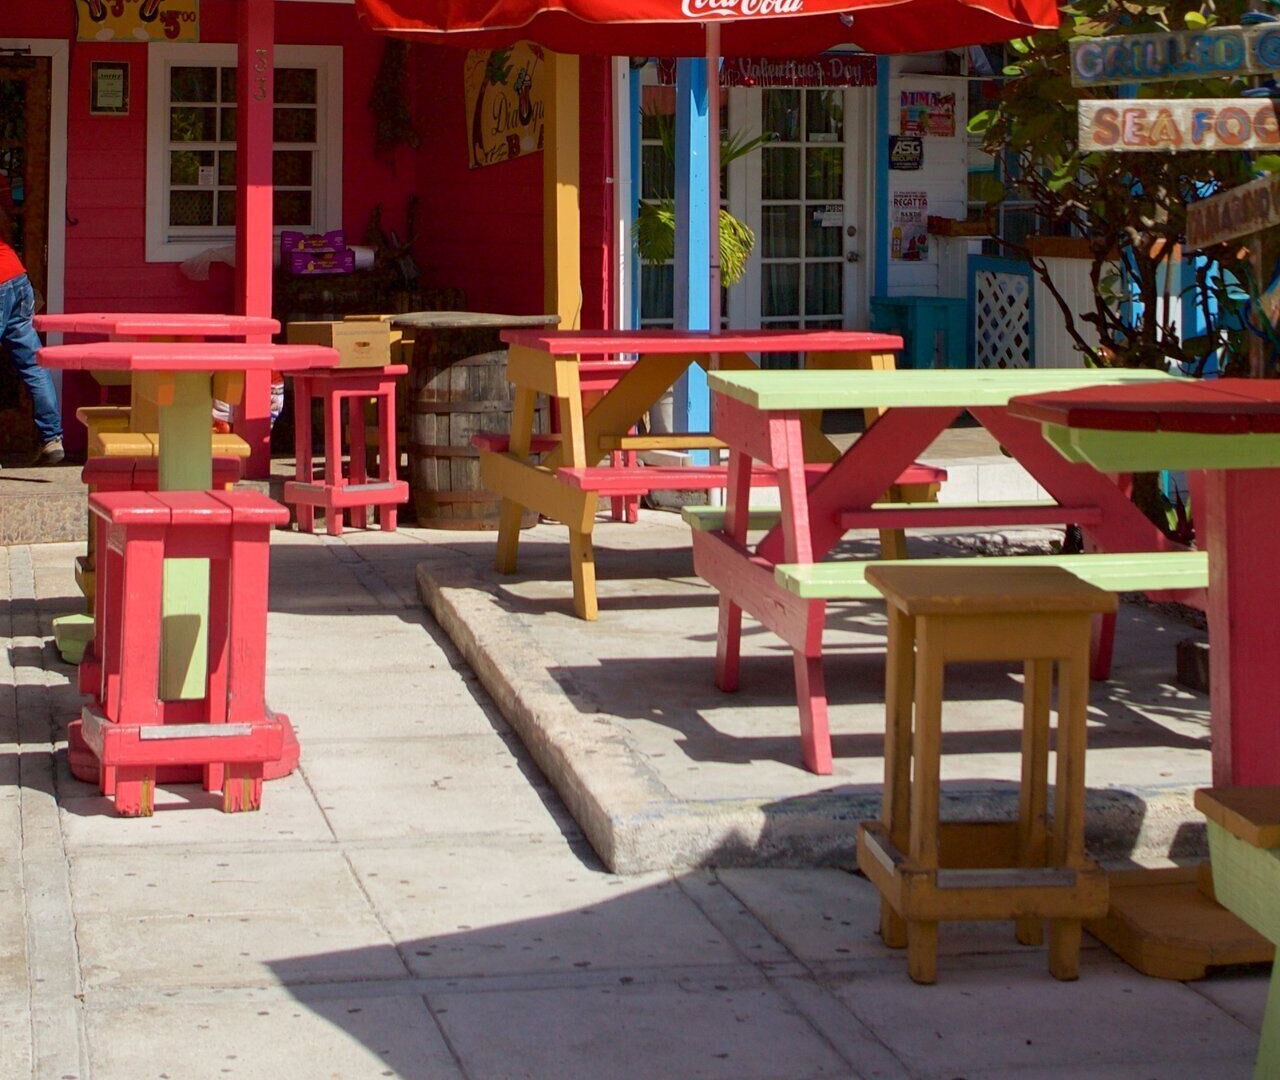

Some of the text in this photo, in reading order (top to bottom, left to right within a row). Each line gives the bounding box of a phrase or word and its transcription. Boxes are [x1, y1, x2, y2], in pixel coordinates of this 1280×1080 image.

[1092, 106, 1183, 146] SEA
[892, 140, 921, 154] ASG
[893, 198, 928, 209] REGATTA
